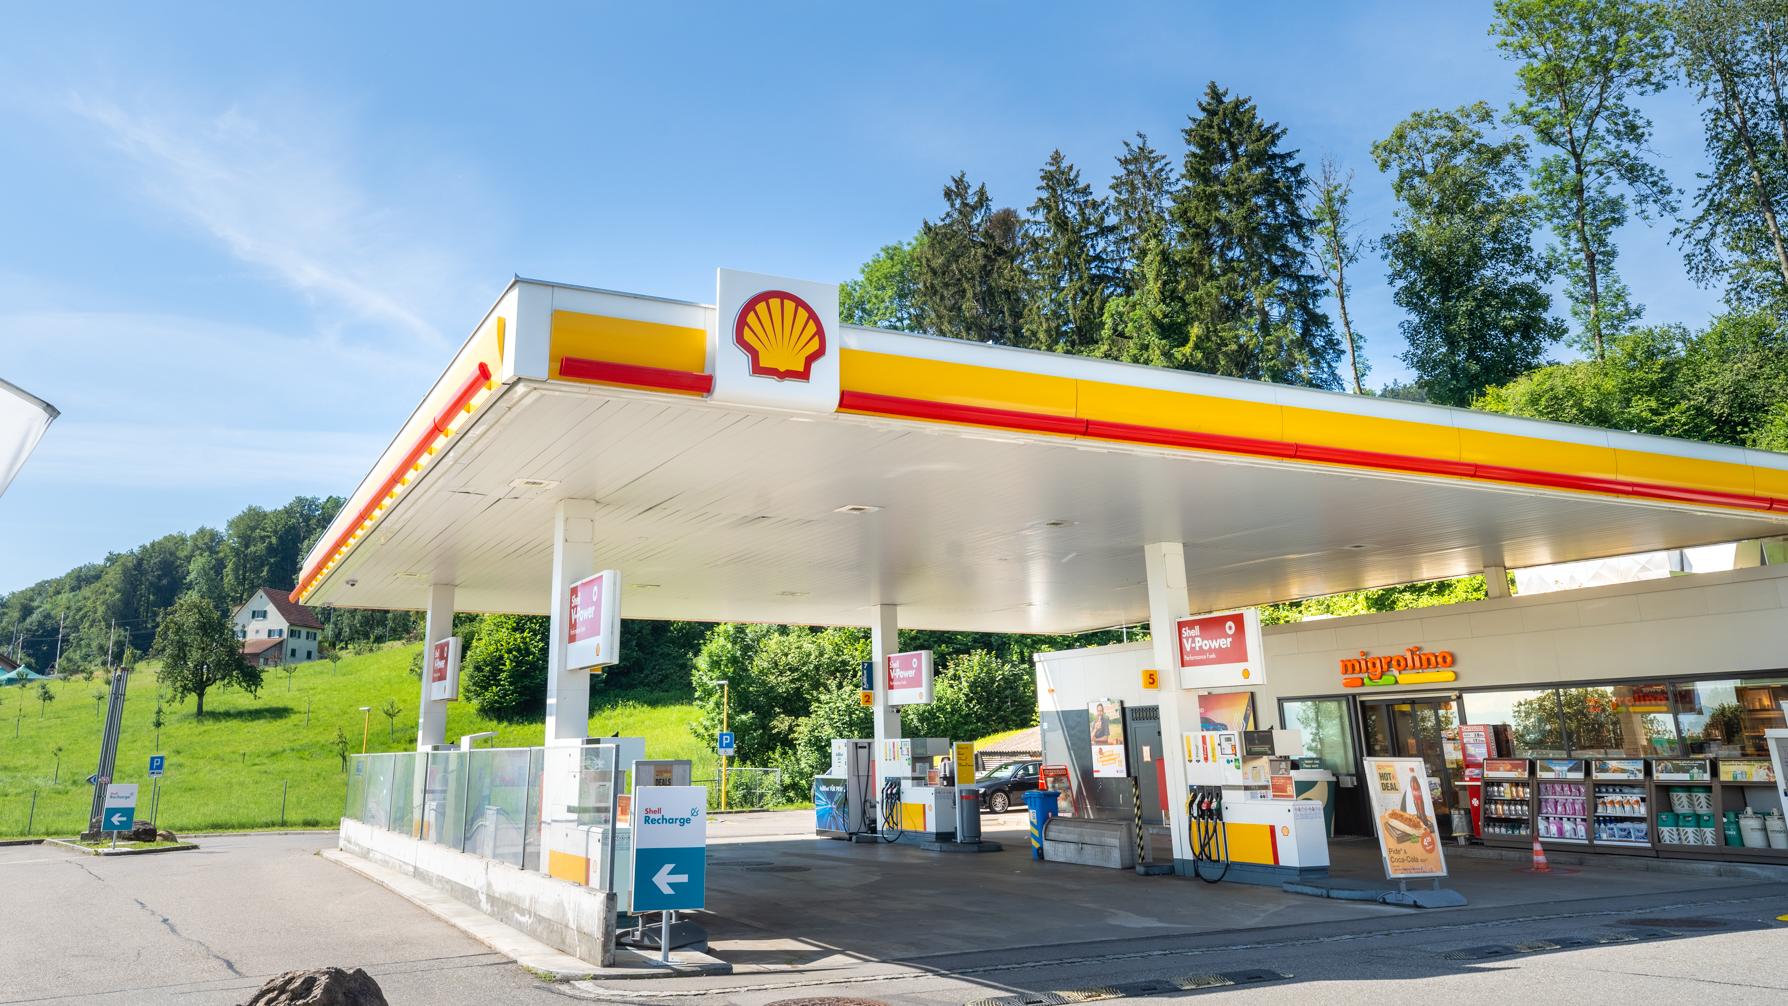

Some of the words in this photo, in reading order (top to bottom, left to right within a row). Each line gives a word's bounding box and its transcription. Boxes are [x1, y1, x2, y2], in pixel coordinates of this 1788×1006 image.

[571, 606, 595, 624] V-Power
[1182, 625, 1200, 638] Shell
[1183, 637, 1232, 651] V-Power
[1339, 646, 1453, 680] migrolino
[890, 668, 916, 680] V-Power
[1148, 674, 1155, 684] 5
[864, 694, 871, 703] 2
[722, 735, 730, 747] P
[655, 778, 672, 786] DEALS
[1378, 772, 1392, 781] HOT
[1380, 782, 1399, 792] DEAL
[644, 807, 662, 815] Shell
[644, 814, 692, 827] Recharge
[1390, 856, 1419, 864] Coca-Cola
